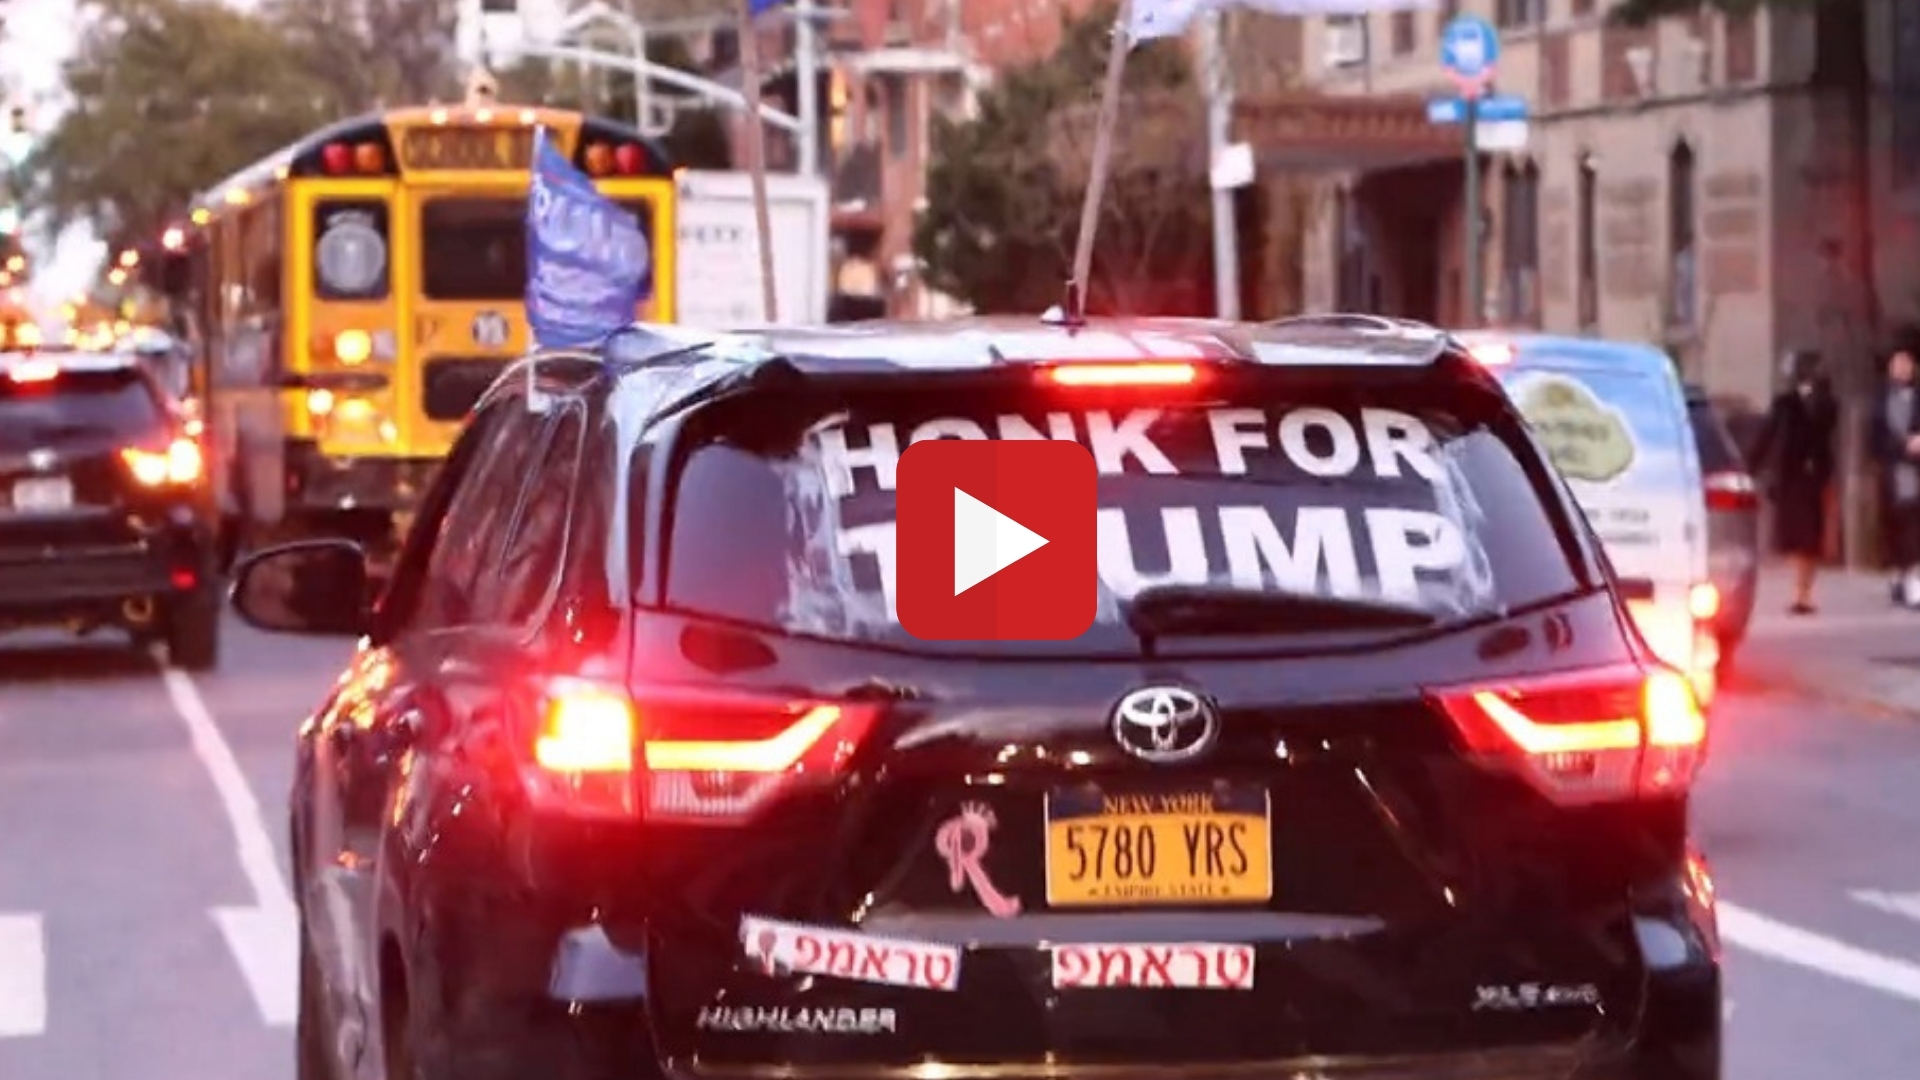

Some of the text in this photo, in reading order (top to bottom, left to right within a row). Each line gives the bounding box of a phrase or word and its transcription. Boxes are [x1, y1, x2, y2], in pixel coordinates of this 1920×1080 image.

[819, 407, 1443, 499] HK FOR
[837, 506, 1467, 622] TUMP
[1102, 792, 1214, 814] NEW YORK
[935, 813, 1021, 918] R
[1066, 821, 1248, 881] 5780 YRS
[1168, 882, 1214, 897] STATE
[794, 934, 954, 988] טראמפ
[1057, 946, 1251, 987] טראמפ
[697, 1006, 896, 1032] HIGHLANDER
